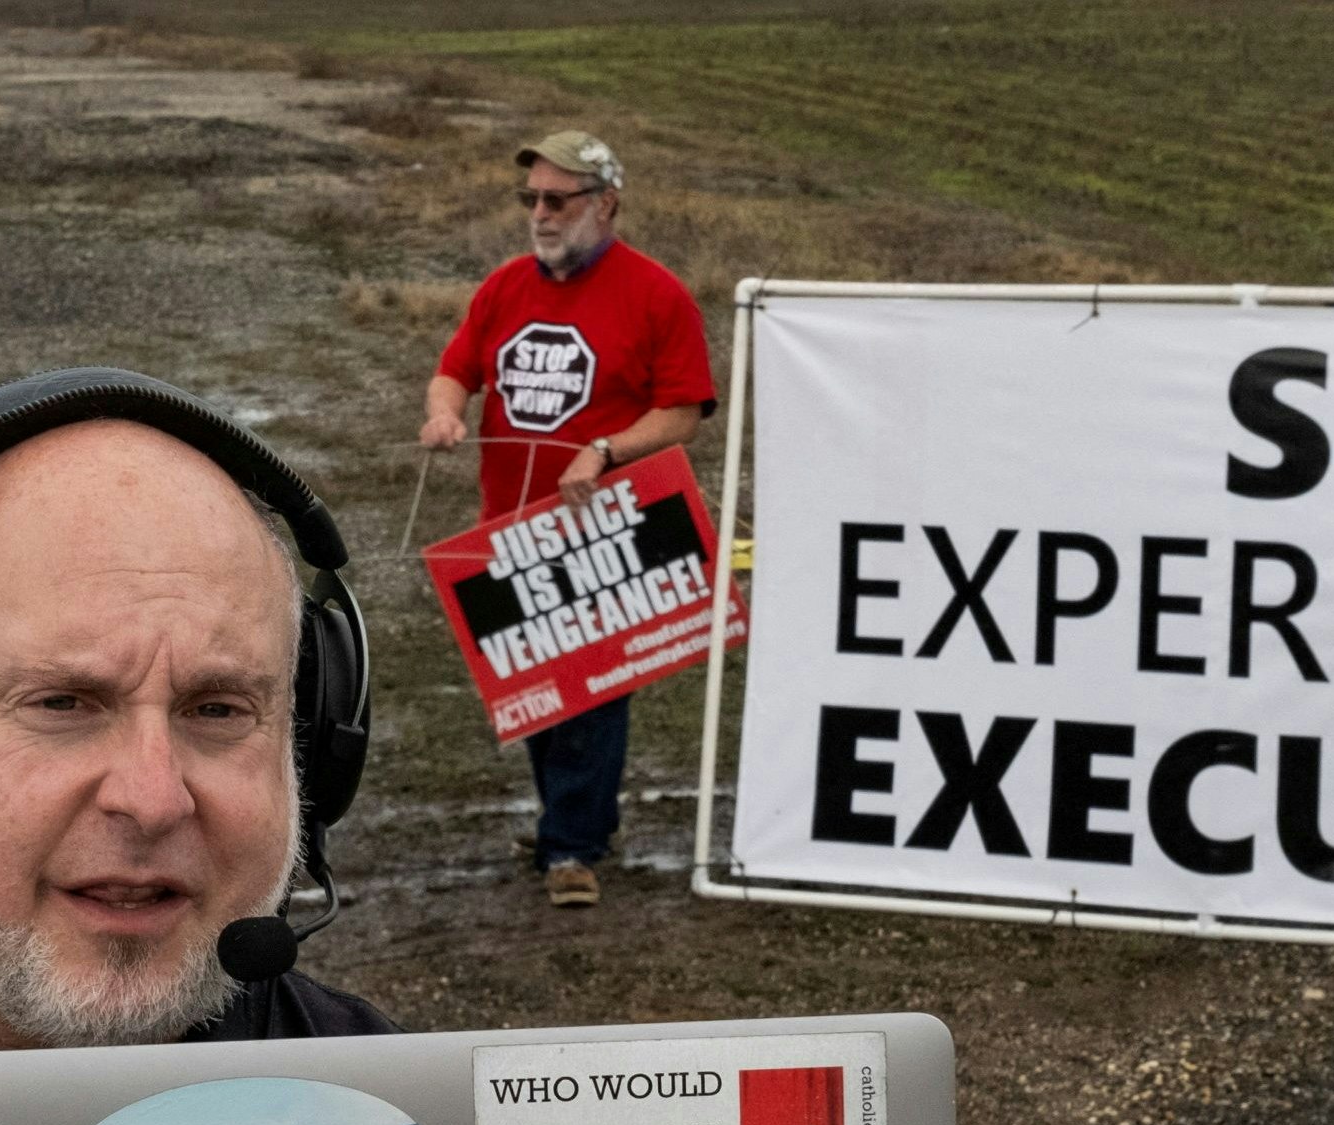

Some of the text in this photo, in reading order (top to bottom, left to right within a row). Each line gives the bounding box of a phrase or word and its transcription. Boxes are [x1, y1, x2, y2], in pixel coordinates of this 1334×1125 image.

[514, 340, 580, 372] STOP
[486, 479, 646, 581] JUSTICE
[510, 529, 644, 618] IS NOT
[478, 551, 711, 680] VENGEANCE!
[494, 687, 564, 736] ACTION
[490, 1071, 722, 1104] WHO WOULD
